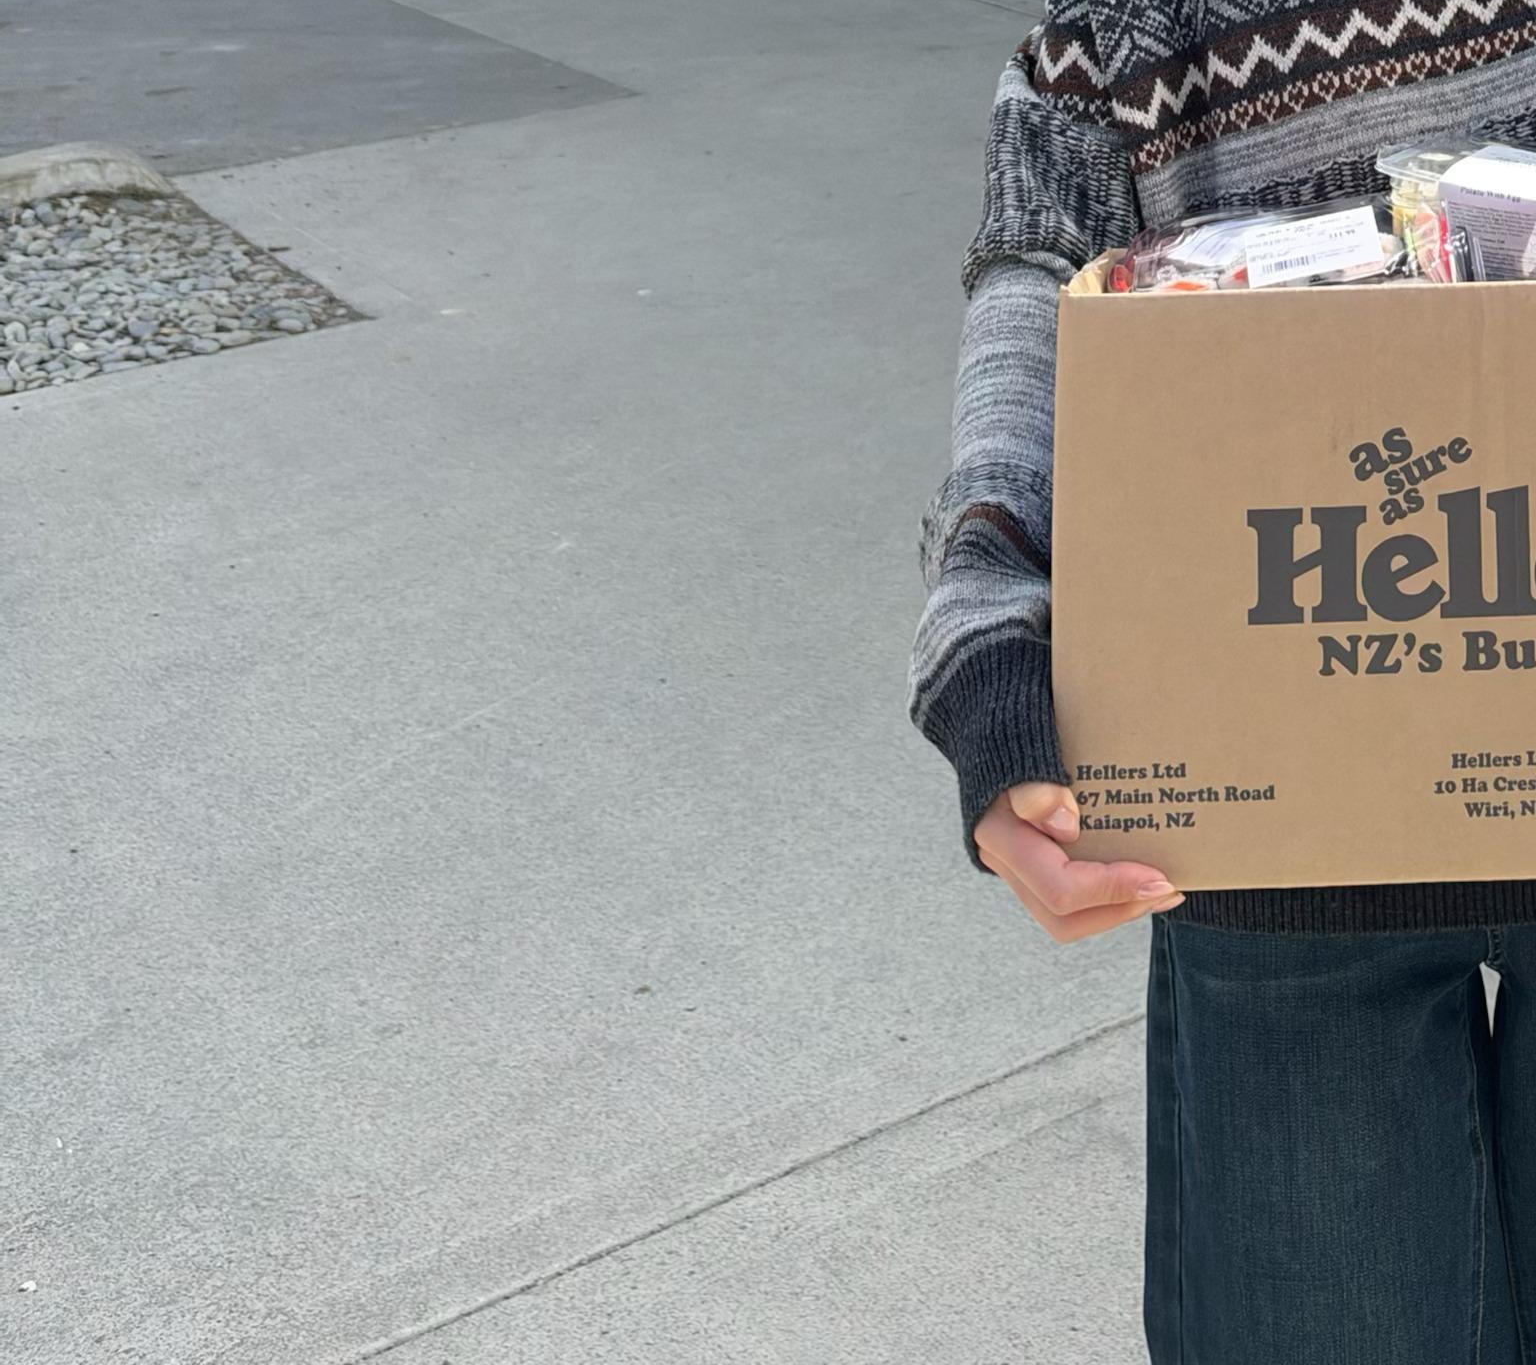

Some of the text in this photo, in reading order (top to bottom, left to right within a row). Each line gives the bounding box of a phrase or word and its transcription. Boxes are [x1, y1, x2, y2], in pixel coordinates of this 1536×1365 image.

[1349, 427, 1413, 481] as
[1384, 437, 1473, 496] sure
[1379, 487, 1424, 526] as
[1319, 632, 1443, 676] NZ's
[1452, 753, 1521, 769] Hellers
[1076, 763, 1186, 781] Hellers Ltd
[1077, 785, 1275, 807] 67 Main North Road
[1434, 780, 1456, 794] 10
[1462, 777, 1488, 793] Ha
[1464, 801, 1515, 819] Wiri,
[1080, 812, 1196, 832] Kaiapoi, NZ
